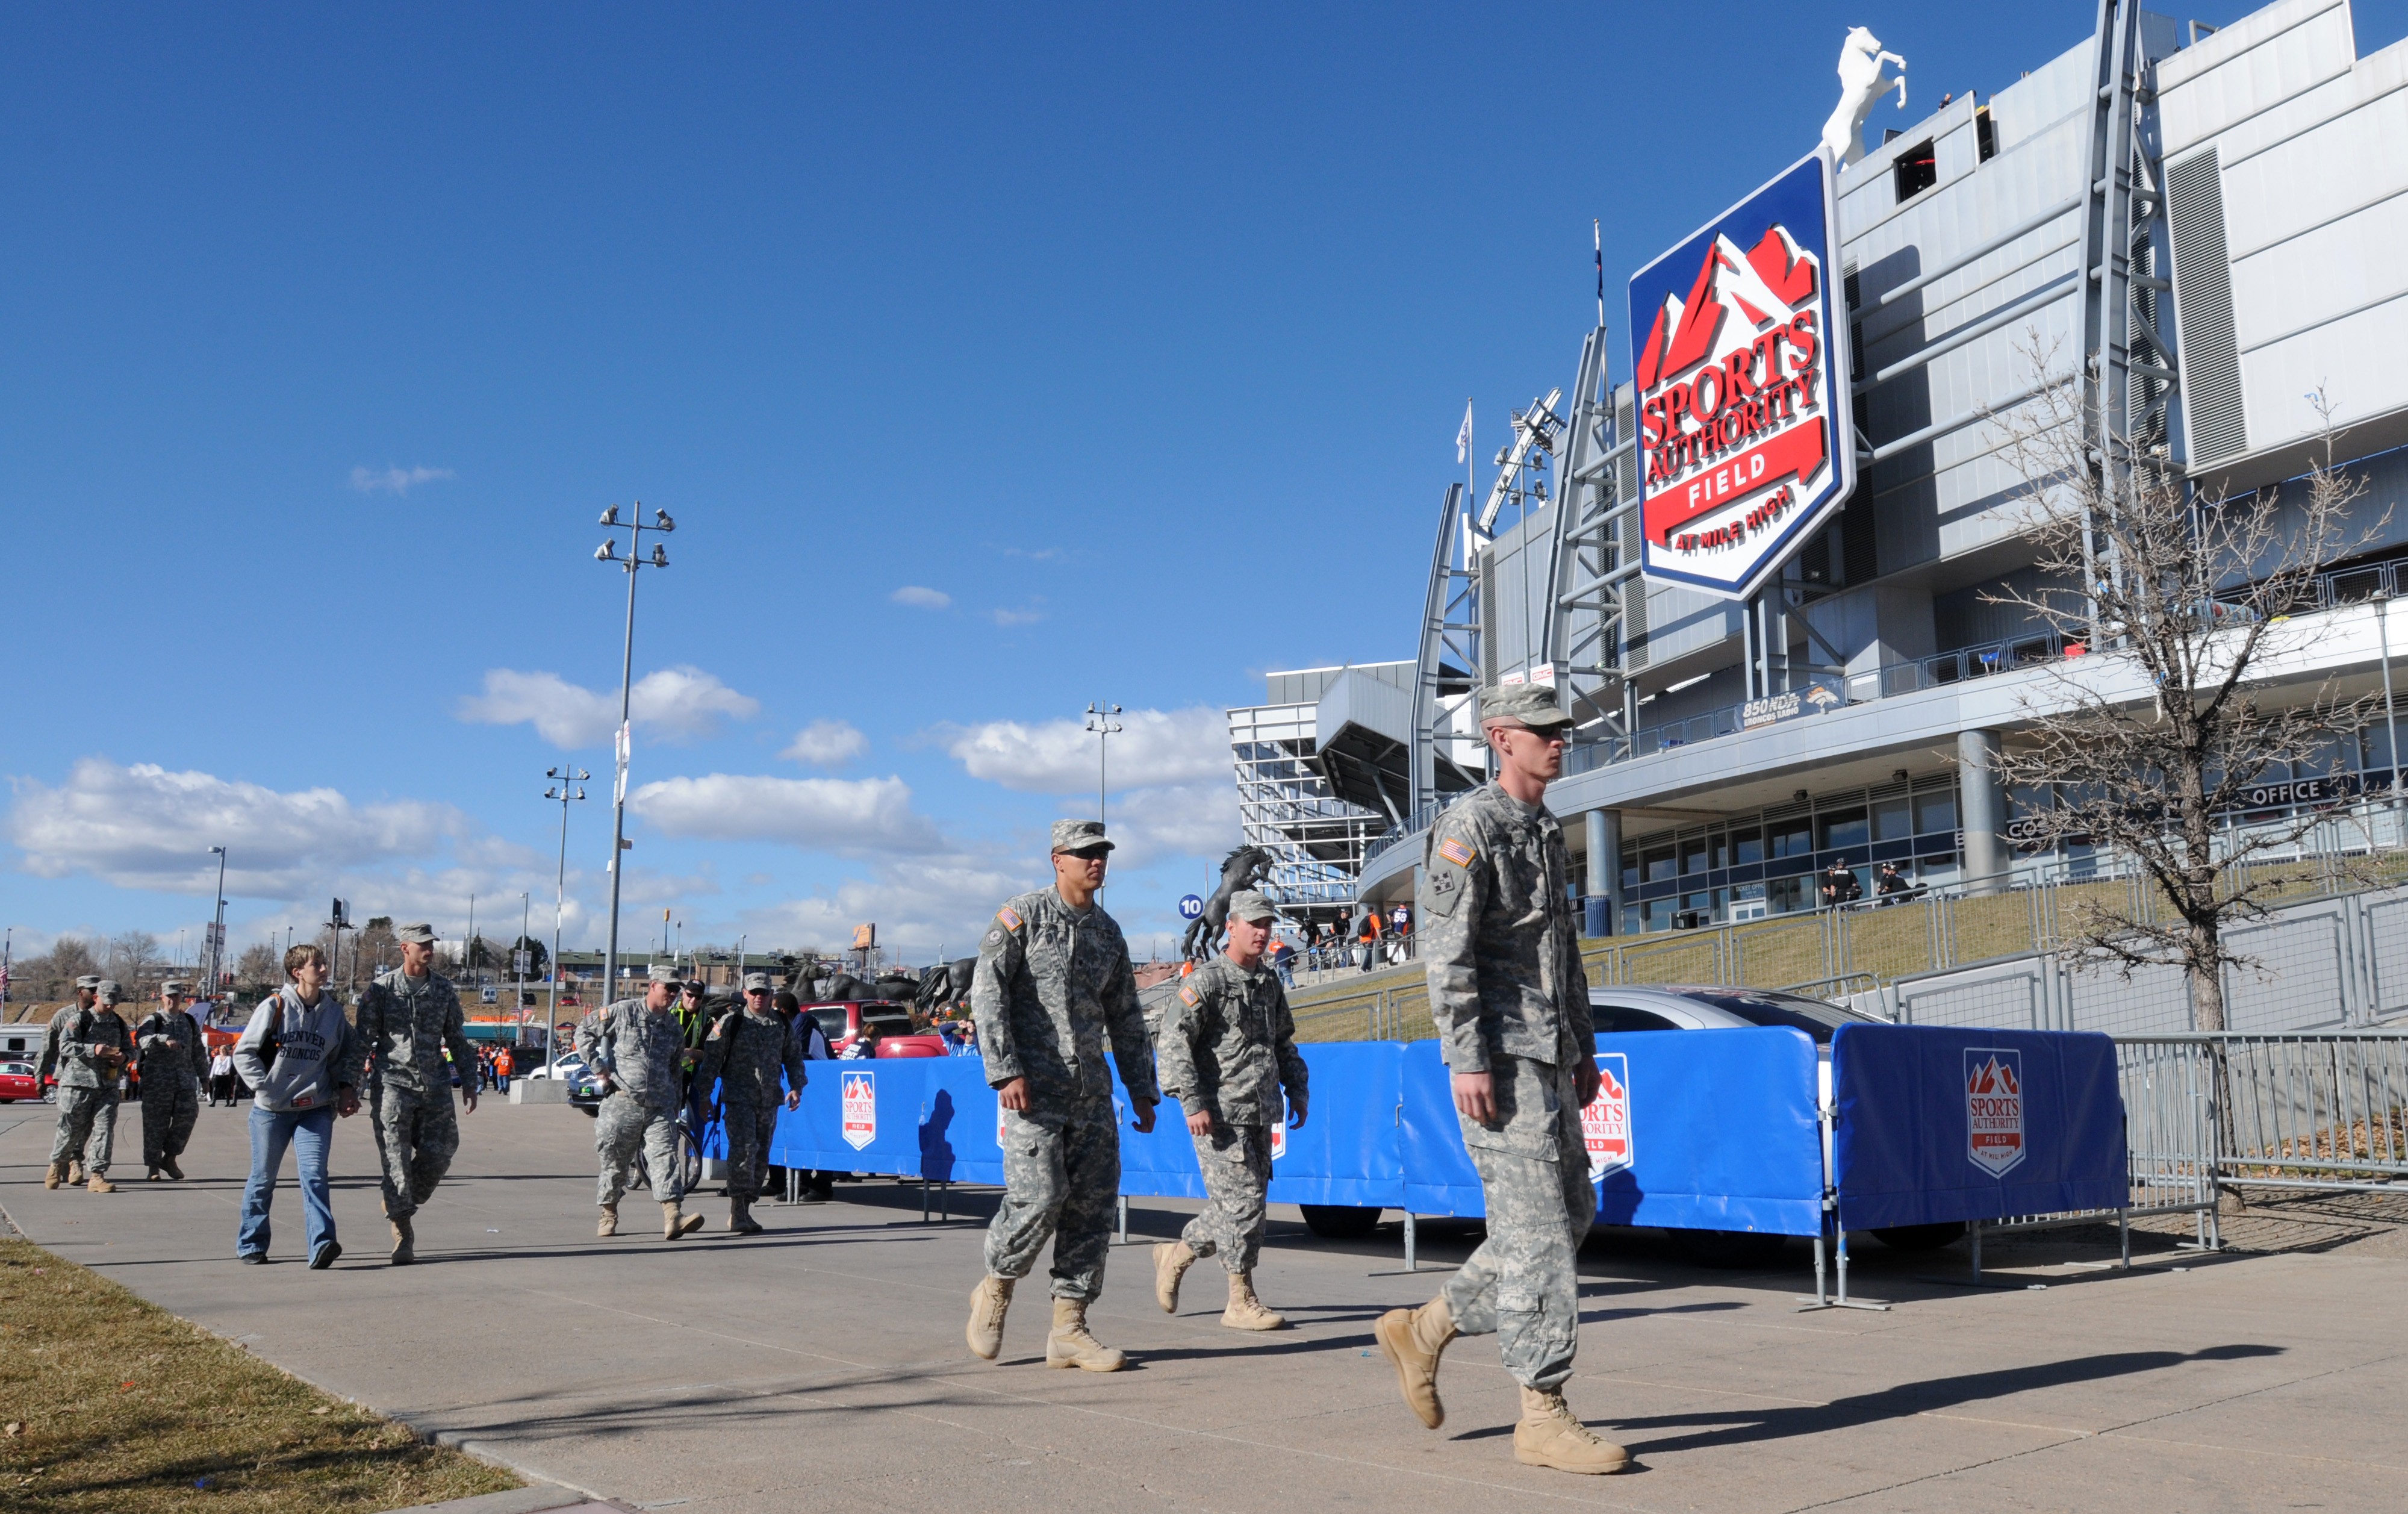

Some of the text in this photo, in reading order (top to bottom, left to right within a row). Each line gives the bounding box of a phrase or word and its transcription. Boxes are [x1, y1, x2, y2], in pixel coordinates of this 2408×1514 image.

[1642, 309, 1815, 450] SPORTS
[1645, 368, 1815, 485] AUTHORITY
[1688, 453, 1765, 508] FIELD
[1675, 484, 1790, 550] AT MILE HIGH
[1533, 669, 1552, 681] GMC
[1743, 699, 1769, 718] 850
[1744, 706, 1799, 727] BRONCOS RADIO
[2253, 781, 2320, 805] OFFICE
[1181, 900, 1201, 914] 10
[279, 1030, 326, 1051] DENVER
[279, 1046, 322, 1061] BRONCOS
[845, 1101, 872, 1113] SPORTS
[1971, 1098, 2019, 1117] SPORTS
[1973, 1118, 2019, 1129] AUTHORITY
[1586, 1140, 1604, 1149] ELD
[1986, 1135, 2007, 1144] FIELD
[1596, 1155, 1613, 1164] HIGH
[2000, 1150, 2013, 1159] HIGH
